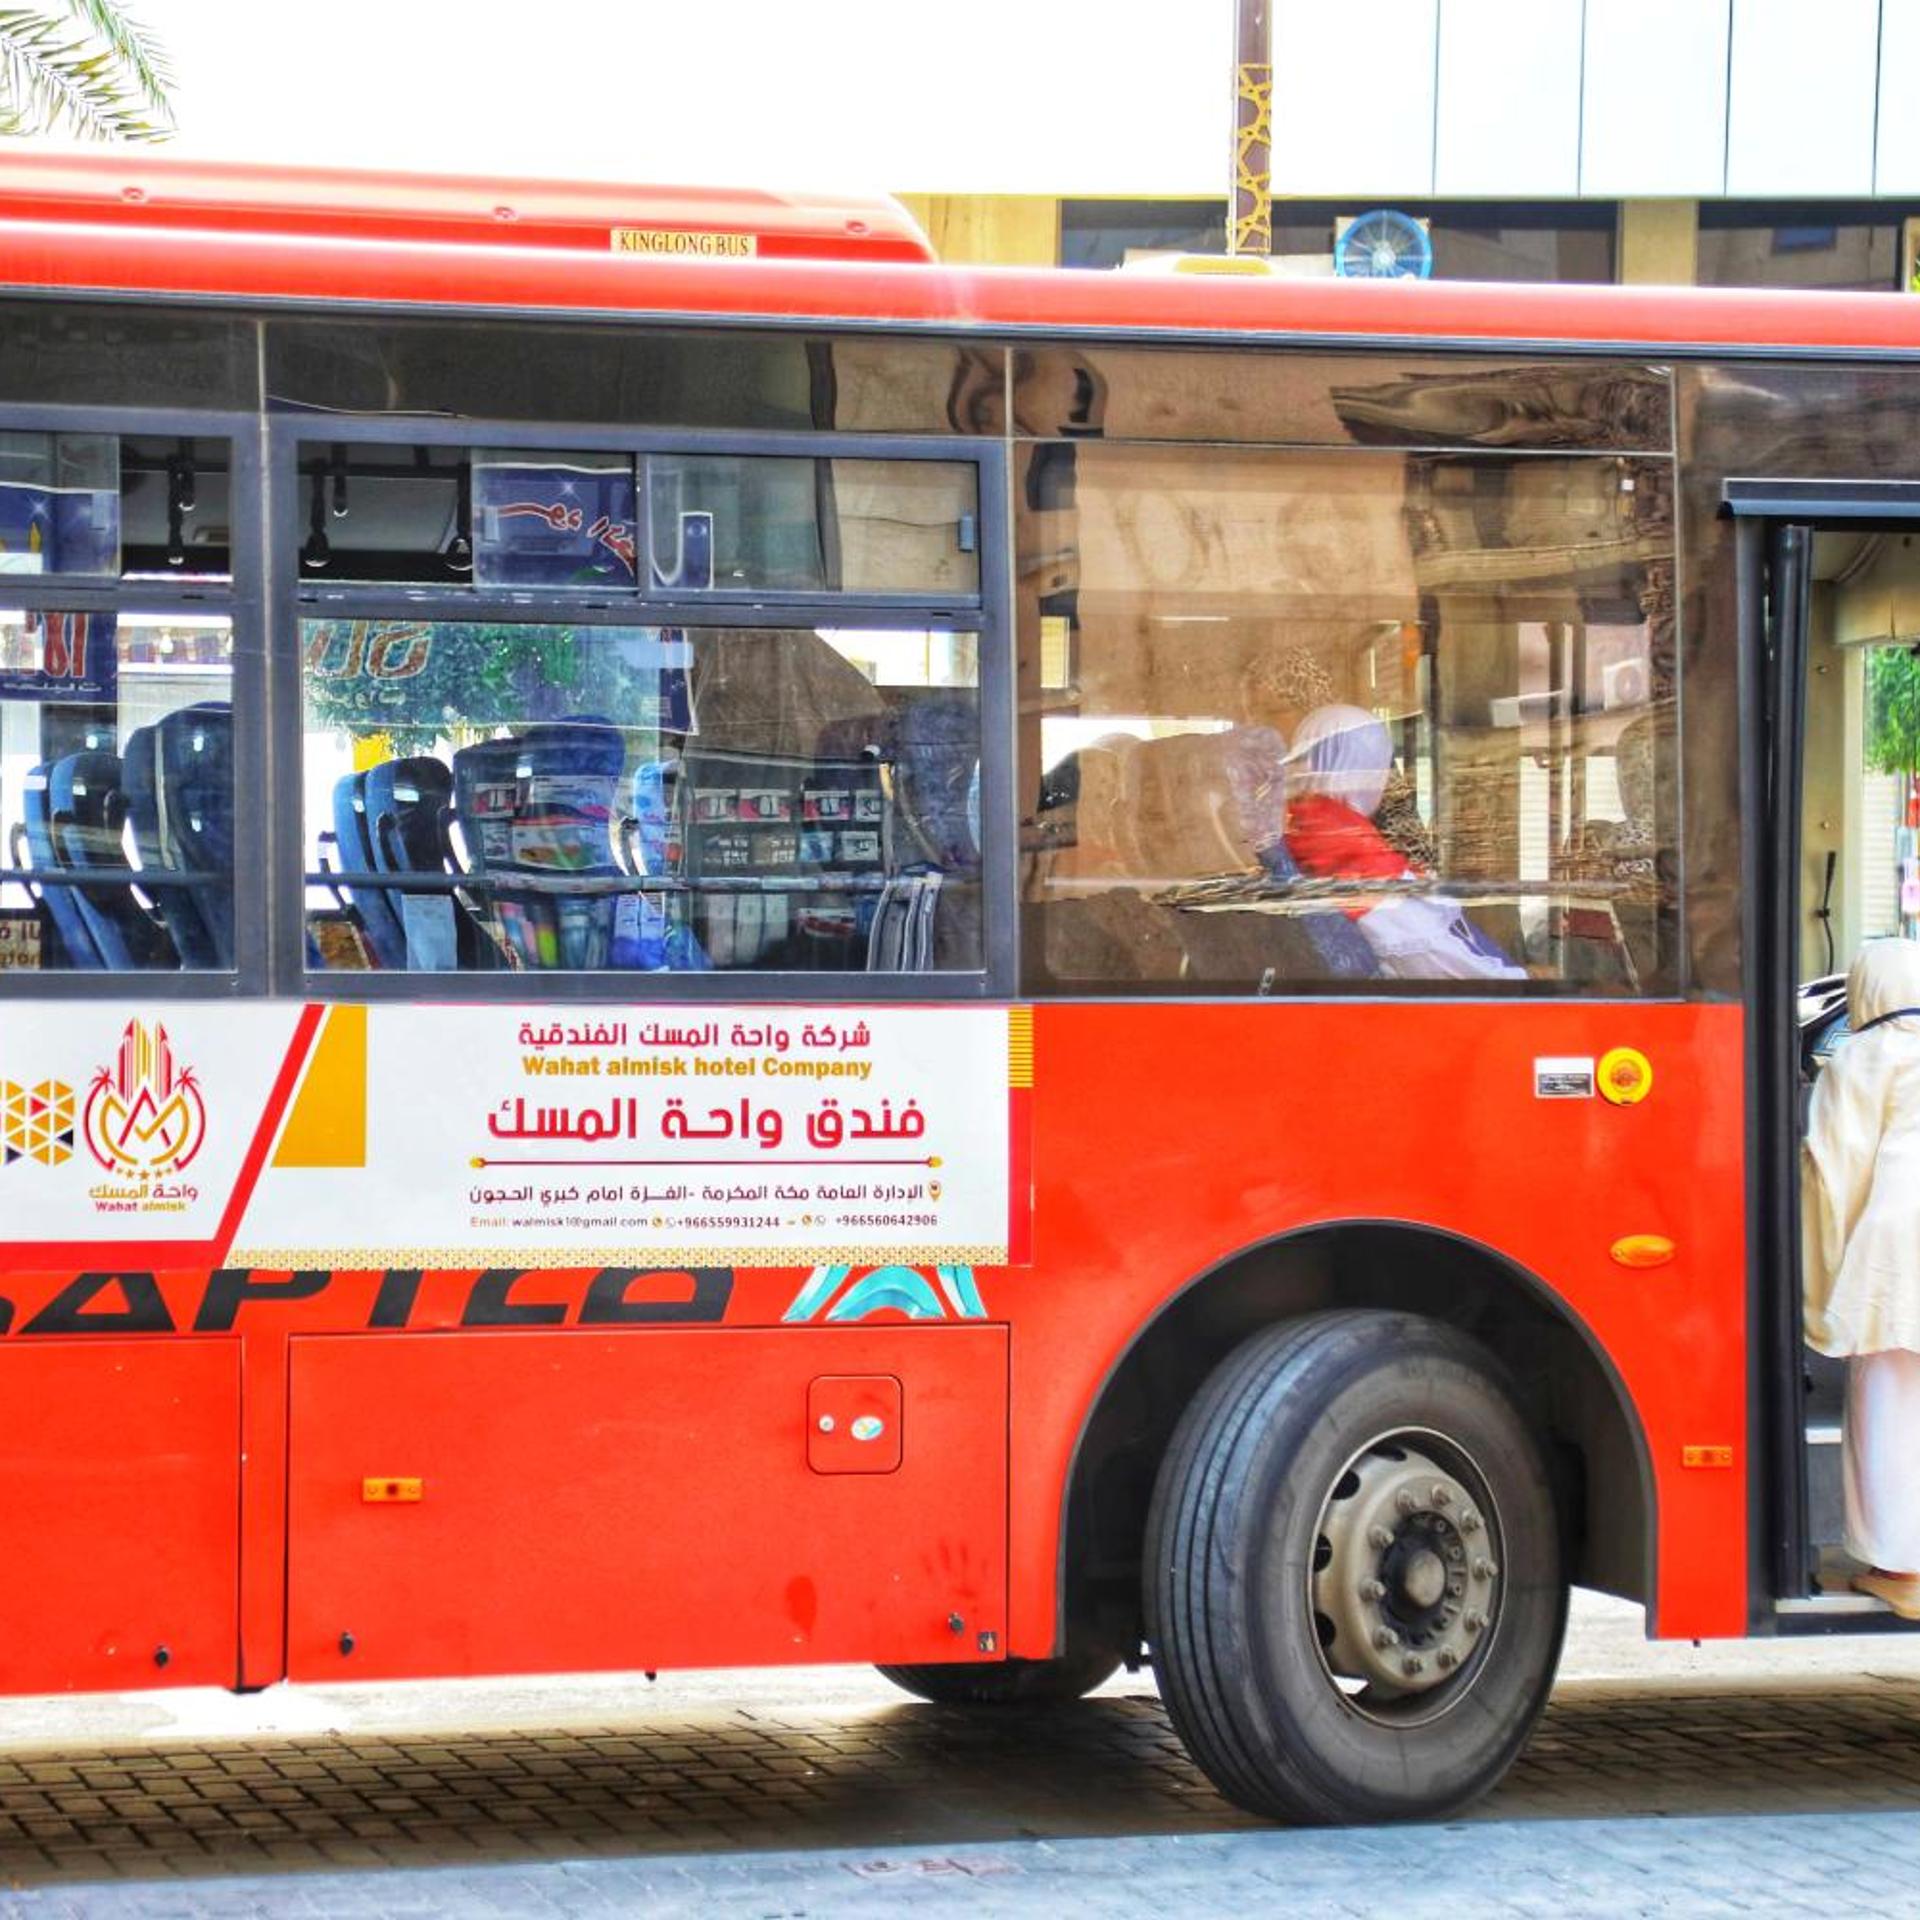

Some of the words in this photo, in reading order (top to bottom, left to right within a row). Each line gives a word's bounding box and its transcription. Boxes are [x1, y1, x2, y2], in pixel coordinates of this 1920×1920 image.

[620, 231, 712, 255] KINGLONG
[716, 236, 749, 256] BUS
[519, 1022, 627, 1050] الفندقية
[639, 1022, 718, 1047] المسك
[731, 1023, 790, 1052] واحة
[802, 1021, 871, 1051] شركة
[522, 1056, 600, 1076] Wahat
[607, 1056, 688, 1076] almisk
[694, 1056, 756, 1076] hotel
[762, 1056, 872, 1080] Company
[487, 1098, 636, 1142] المسك
[661, 1098, 783, 1149] واحة
[806, 1098, 925, 1149] فندق
[89, 1183, 148, 1200] المسك
[152, 1183, 199, 1201] واحة
[702, 1184, 768, 1204] المكرمة
[774, 1184, 811, 1201] مكة
[816, 1184, 868, 1201] العامة
[95, 1201, 138, 1213] Wahat
